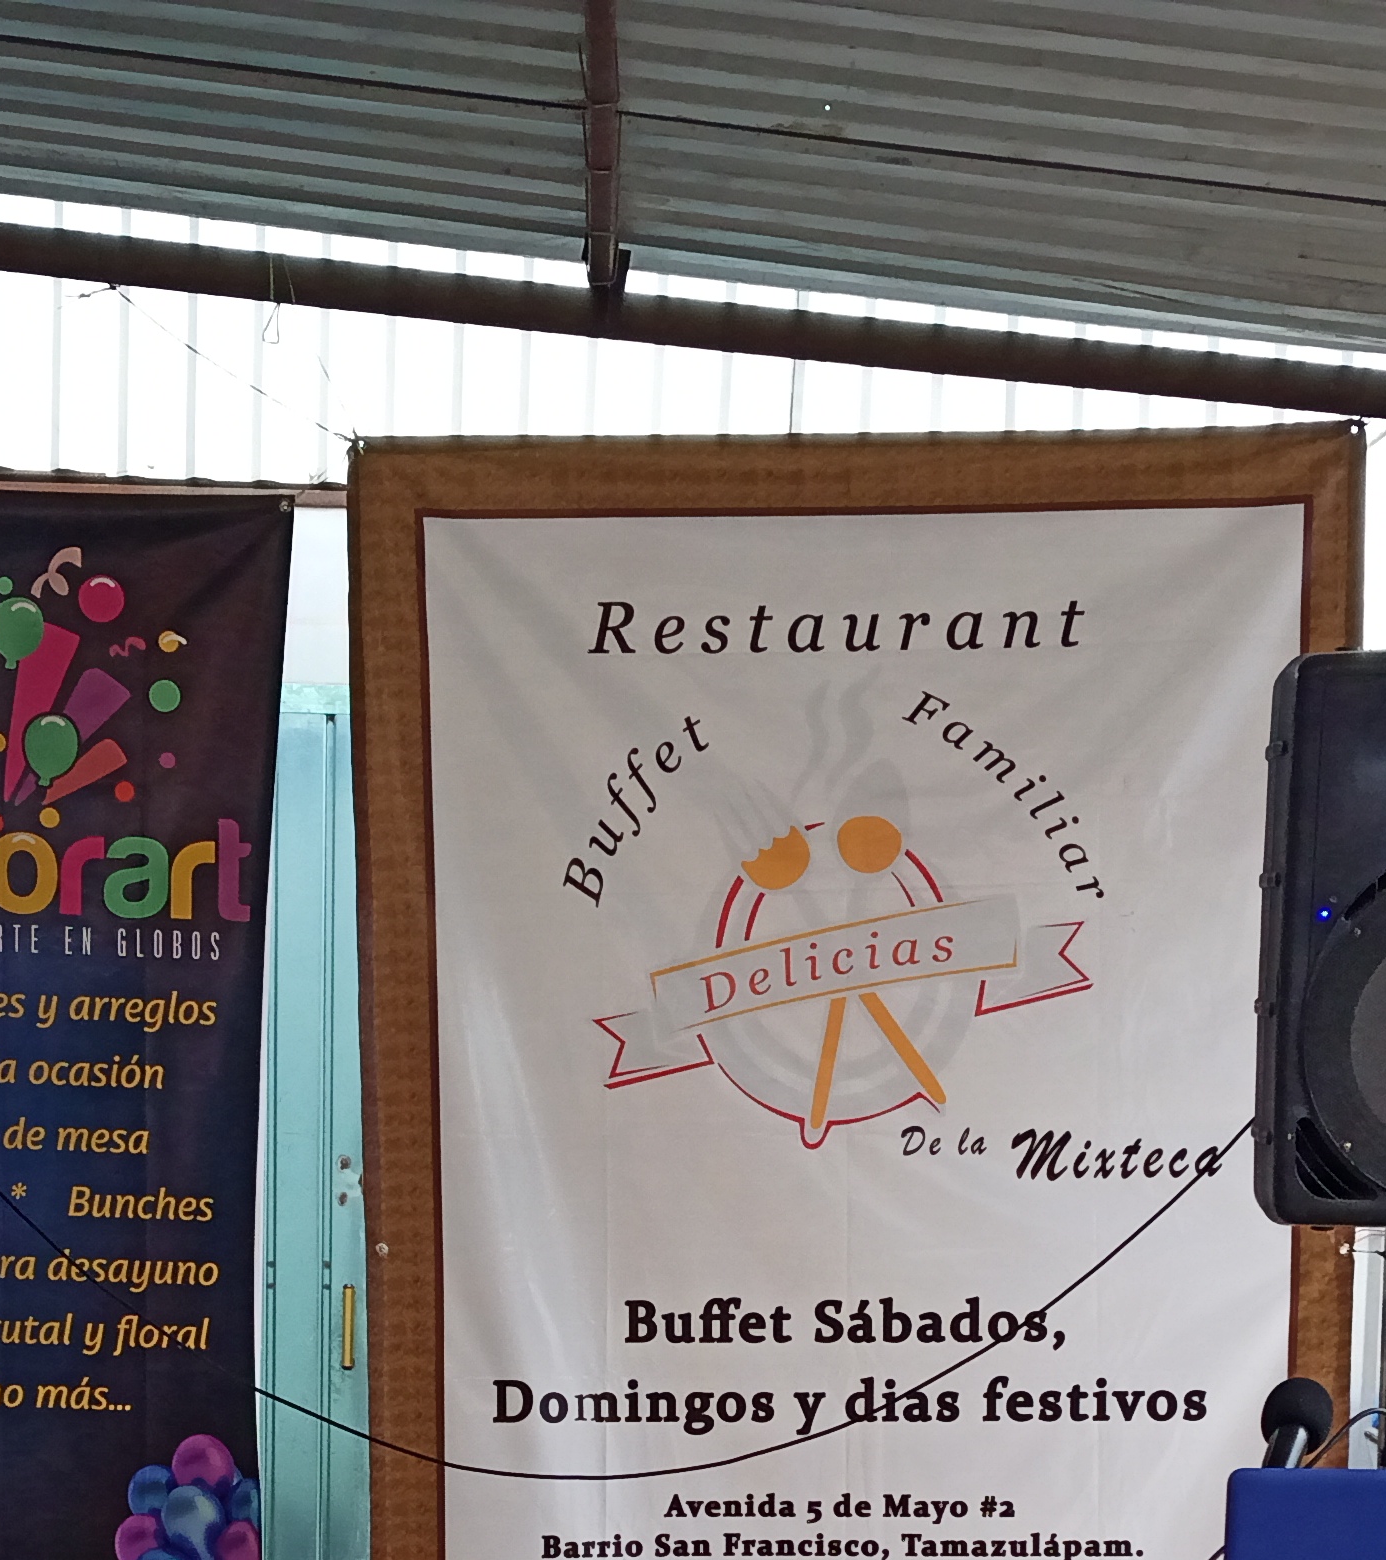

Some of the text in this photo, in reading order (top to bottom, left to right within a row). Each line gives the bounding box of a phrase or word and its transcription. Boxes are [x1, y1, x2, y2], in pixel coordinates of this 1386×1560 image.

[587, 599, 1085, 656] Restaurant
[563, 714, 710, 908] Buffet
[901, 690, 1105, 901] Familiar
[64, 925, 92, 956] EN
[116, 927, 220, 960] GLOBOS
[698, 930, 955, 1014] Delicias
[37, 994, 58, 1028] y
[69, 990, 218, 1032] arreglos
[28, 1055, 165, 1090] ocasión
[3, 1116, 46, 1150] de
[56, 1125, 150, 1155] mesa
[900, 1124, 1224, 1182] De la Mixteca
[67, 1184, 214, 1223] Bunches
[46, 1247, 220, 1293] desayuno
[84, 1319, 105, 1356] y
[112, 1313, 210, 1357] floral
[623, 1295, 1068, 1353] Buffet Sábados,
[35, 1374, 133, 1412] más...
[492, 1377, 777, 1436] Domingos
[794, 1389, 826, 1436] y
[981, 1377, 1209, 1423] festivos
[663, 1493, 1017, 1527] Avenida 5 de Mayo #2
[541, 1532, 644, 1560] Barrio
[653, 1532, 713, 1559] San
